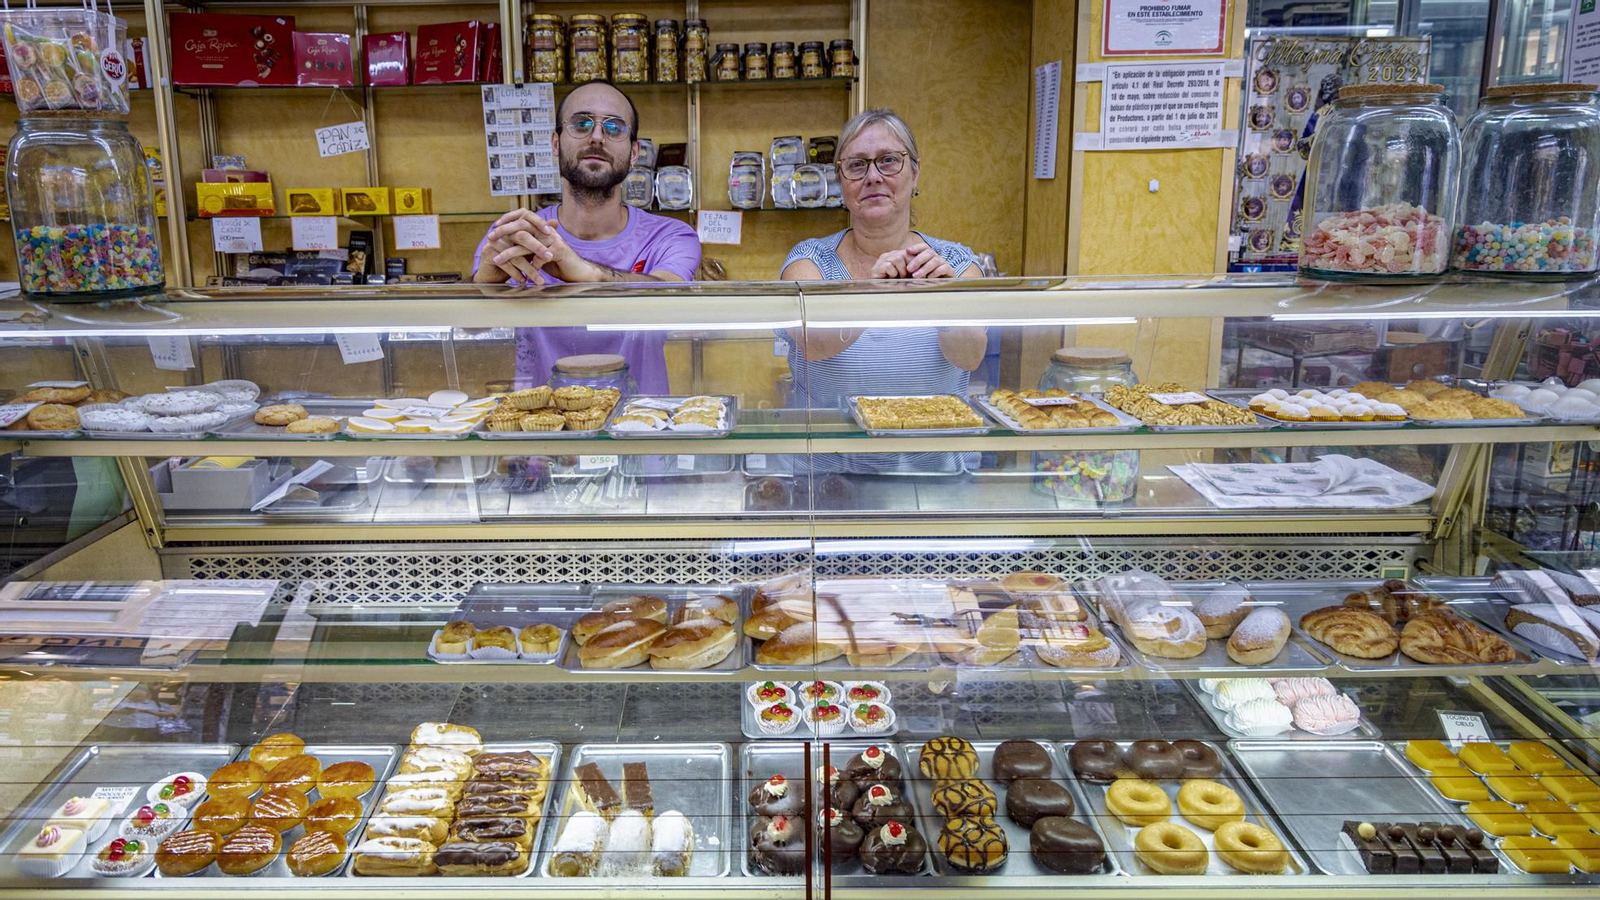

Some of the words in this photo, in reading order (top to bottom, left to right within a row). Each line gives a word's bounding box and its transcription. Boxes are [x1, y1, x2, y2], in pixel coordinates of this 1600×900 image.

[185, 39, 206, 53] Caja
[209, 38, 238, 51] Roja
[1256, 38, 1341, 71] Magna
[1123, 70, 1145, 79] aplicación
[1162, 69, 1185, 78] obligación
[1187, 69, 1205, 78] prevista
[1368, 67, 1419, 81] 2022
[501, 89, 532, 97] LOTERIA
[1132, 103, 1149, 111] plástico
[1200, 101, 1218, 110] Registro
[1187, 112, 1197, 120] julio
[318, 126, 349, 143] PAN
[1141, 136, 1160, 144] siguiente
